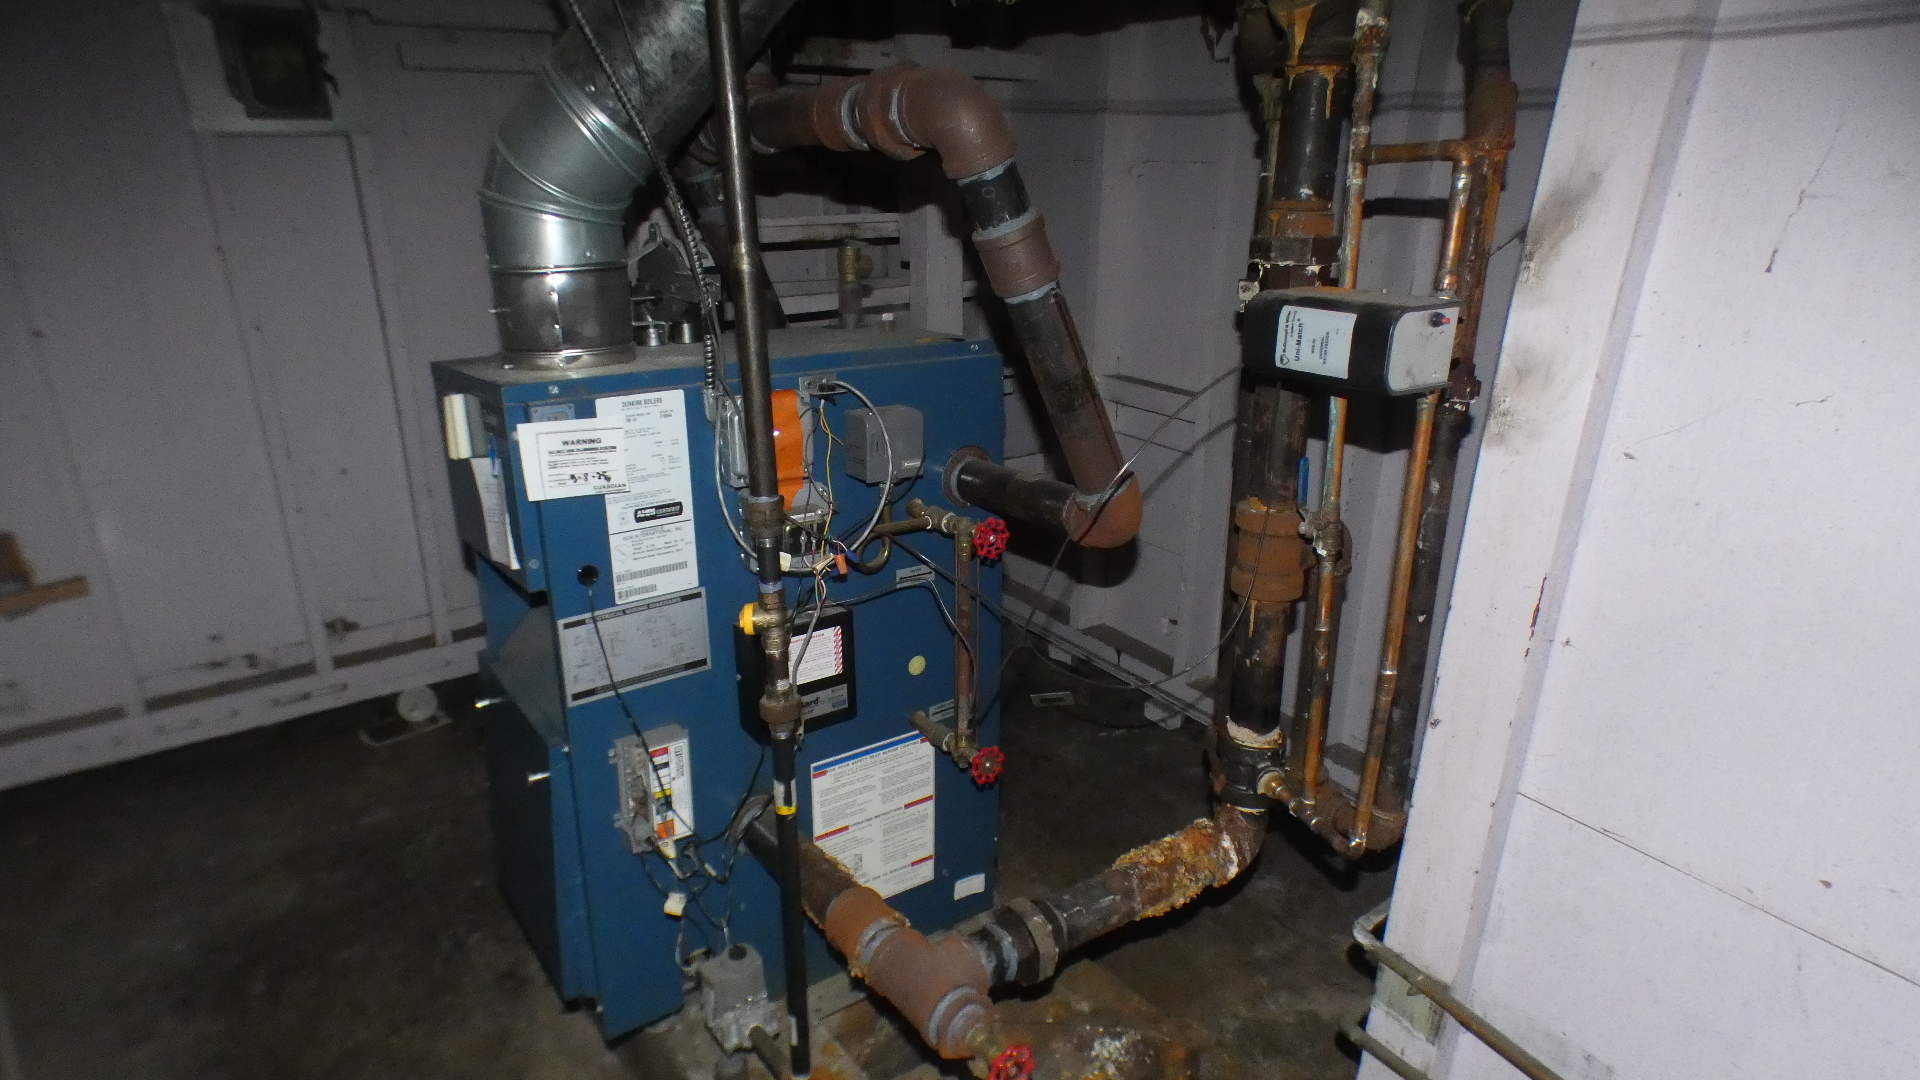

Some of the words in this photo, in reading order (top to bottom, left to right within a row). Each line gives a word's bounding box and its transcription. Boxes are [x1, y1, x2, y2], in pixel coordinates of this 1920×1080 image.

[622, 400, 643, 408] DUNKIRK
[644, 398, 662, 406] BOILERS
[562, 438, 602, 446] WARNING
[851, 757, 868, 766] SAFETY
[882, 746, 899, 756] BEFORE
[900, 740, 920, 751] LIGHTING
